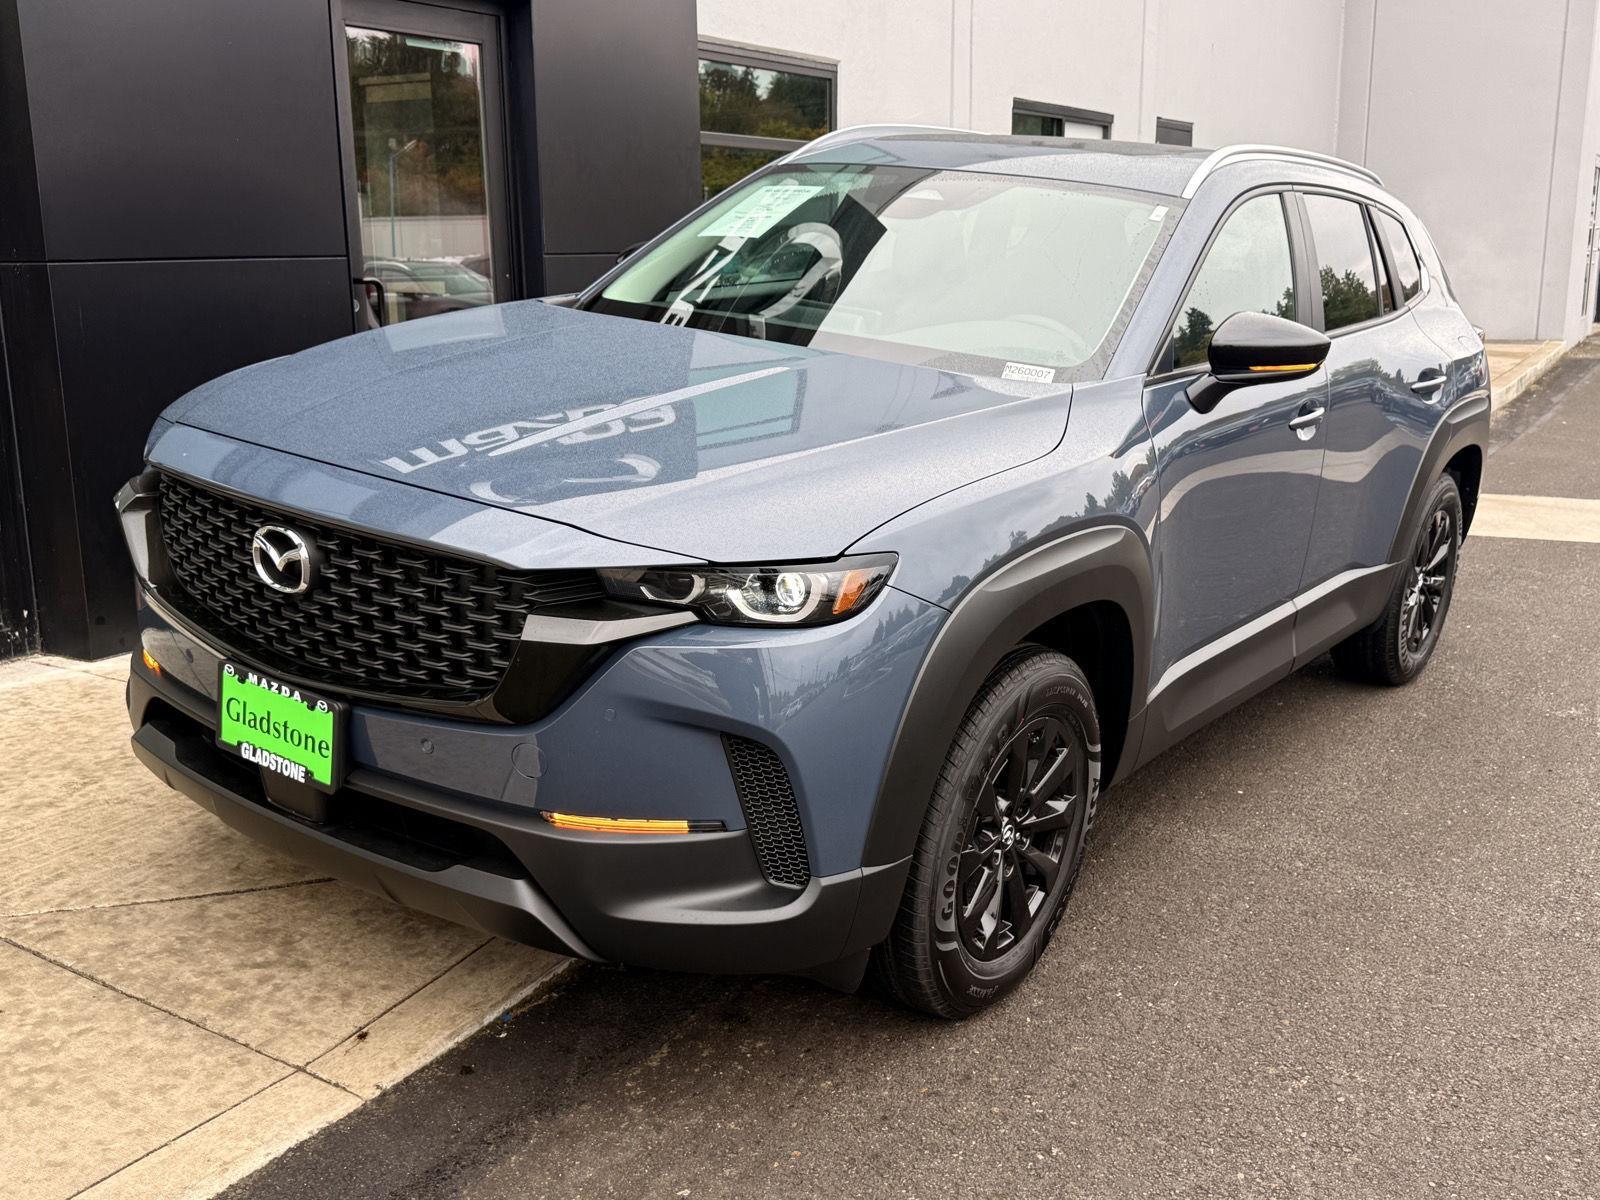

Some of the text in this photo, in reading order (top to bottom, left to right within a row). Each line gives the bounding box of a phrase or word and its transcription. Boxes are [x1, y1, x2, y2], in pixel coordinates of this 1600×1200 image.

[248, 672, 302, 703] MAZDA
[226, 697, 330, 759] Gladstone
[241, 742, 306, 783] GLADSTONE
